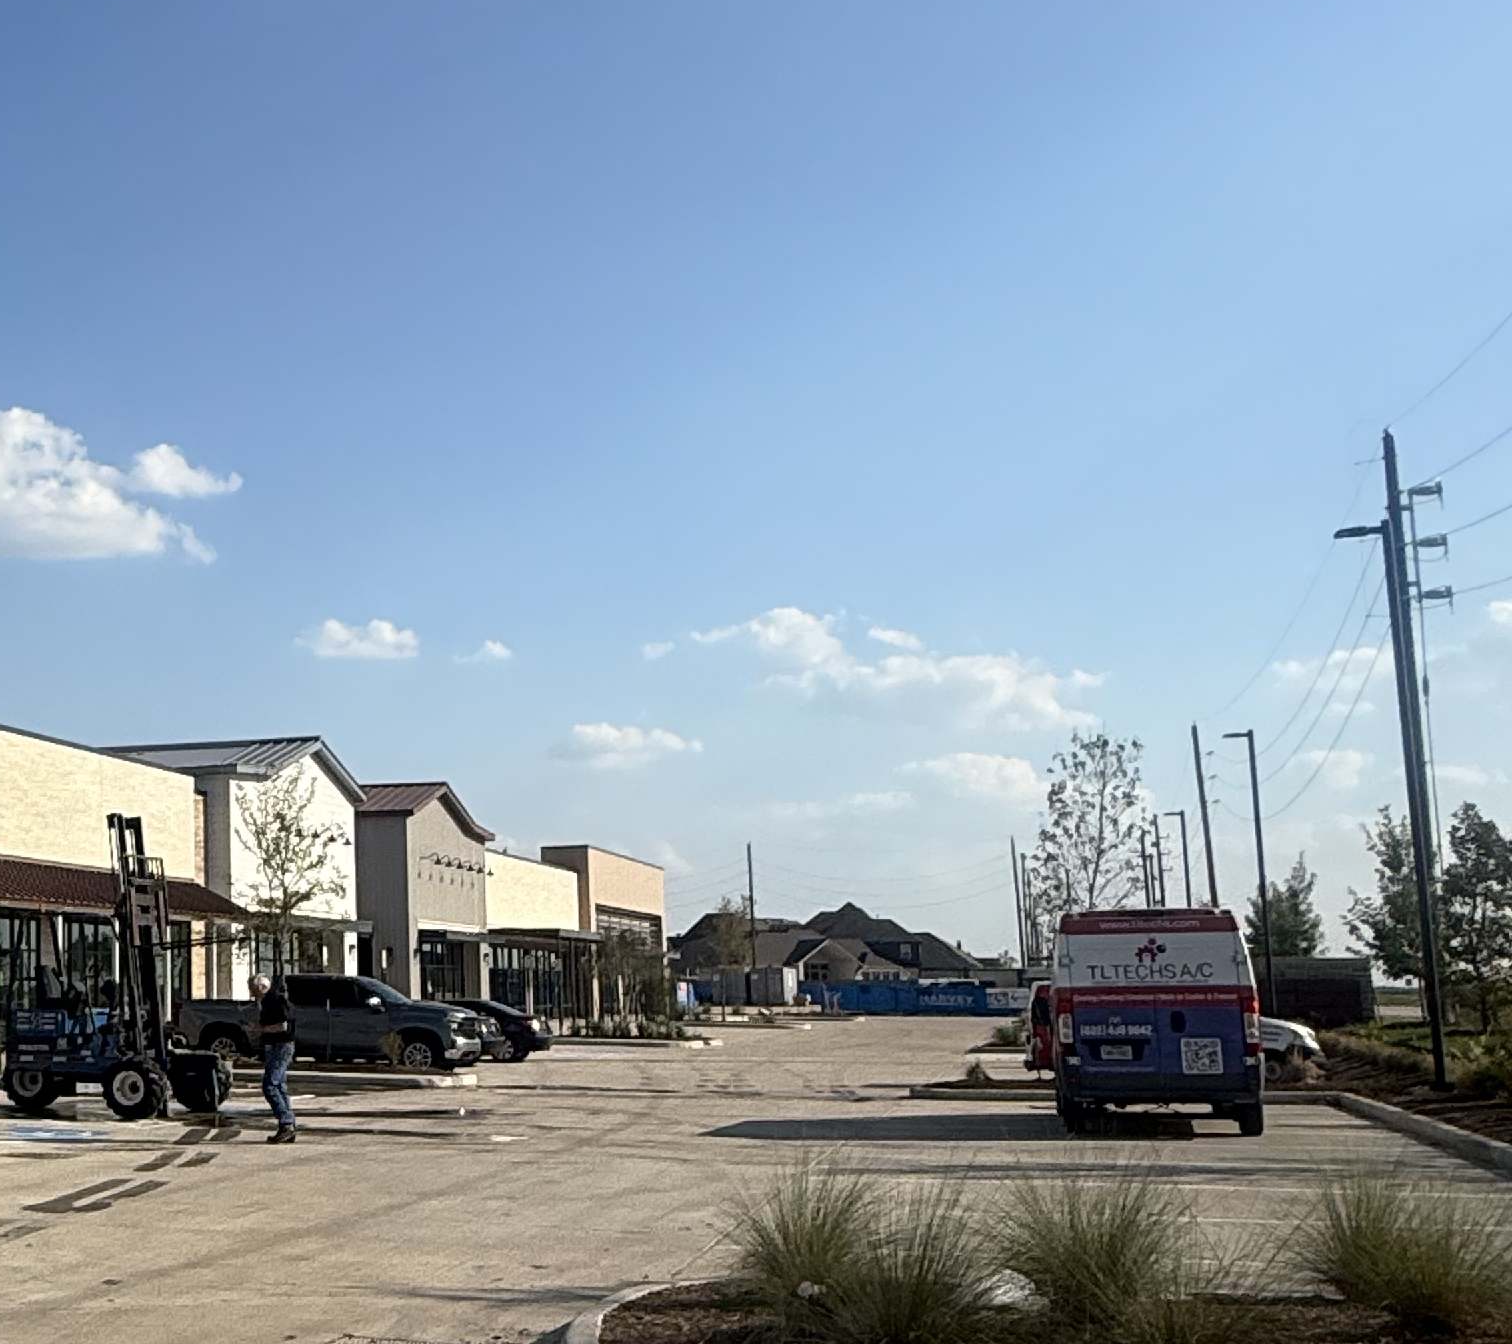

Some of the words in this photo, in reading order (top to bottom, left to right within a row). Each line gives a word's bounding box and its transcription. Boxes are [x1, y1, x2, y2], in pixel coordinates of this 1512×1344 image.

[1086, 964, 1177, 980] TLTECHS
[1180, 962, 1214, 978] A/C
[918, 993, 975, 1007] HARVEY
